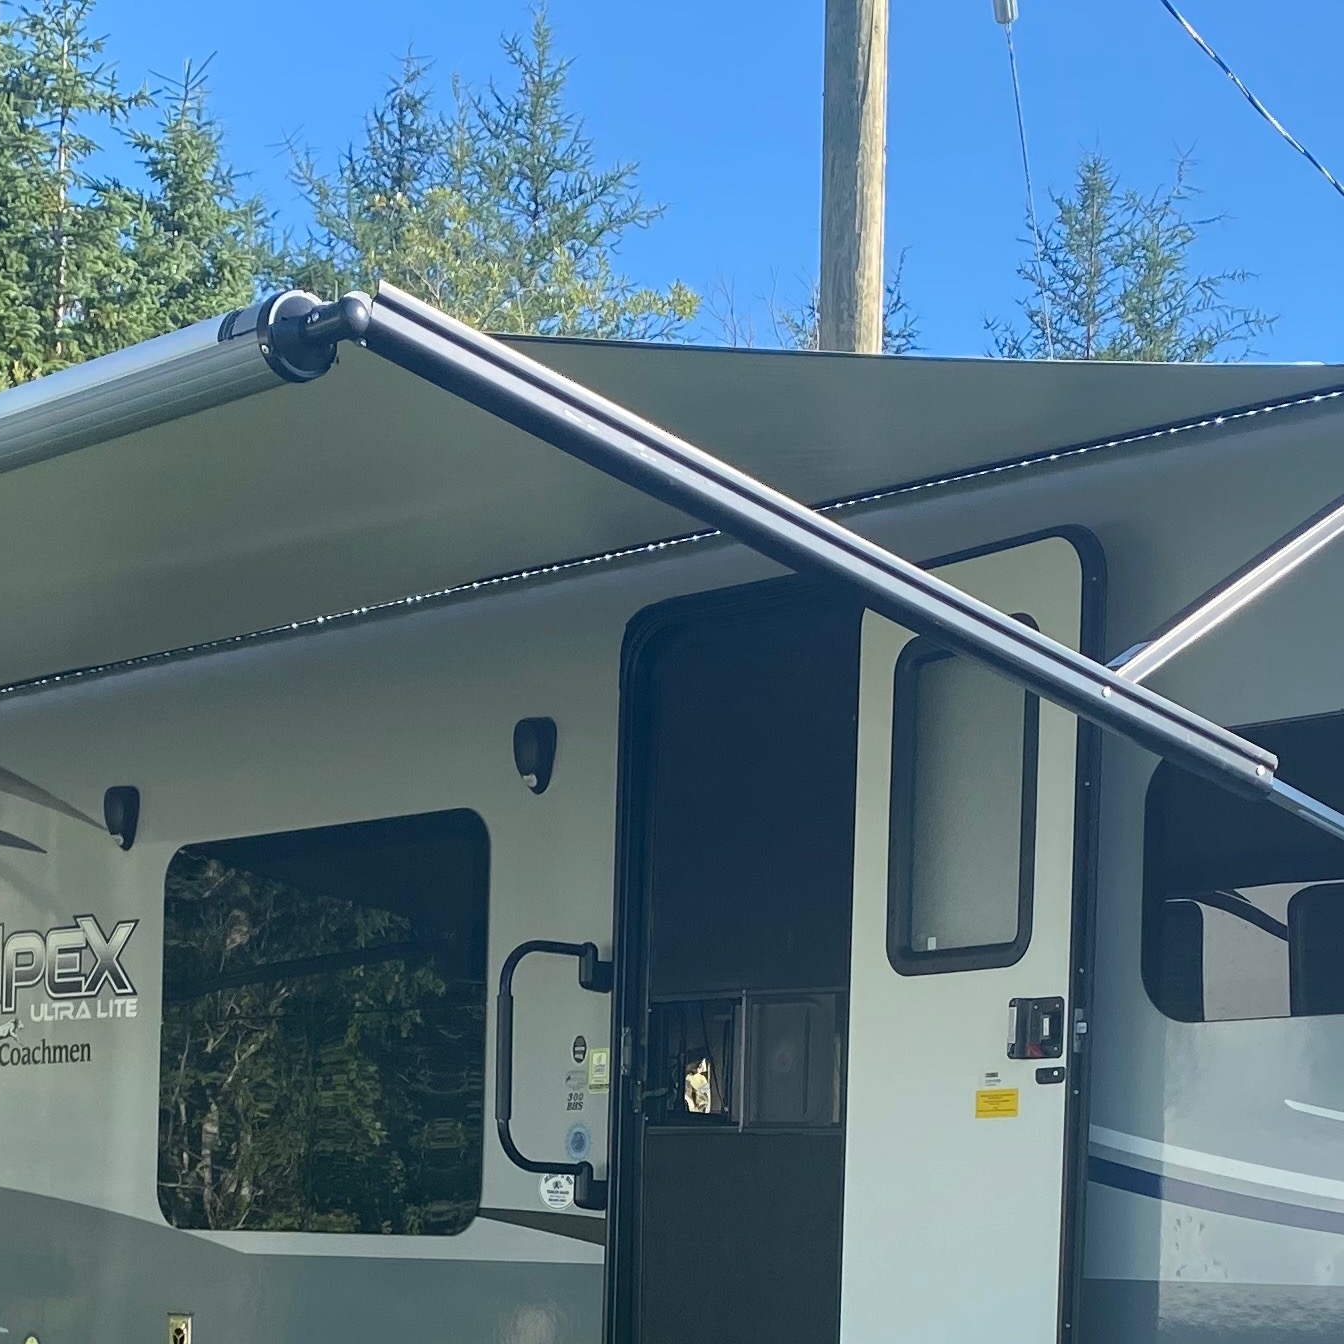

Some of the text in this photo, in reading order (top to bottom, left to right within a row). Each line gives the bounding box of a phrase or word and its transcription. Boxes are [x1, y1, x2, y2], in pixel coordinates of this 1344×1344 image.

[30, 998, 138, 1023] ULTRA LITE
[567, 1092, 584, 1102] 300
